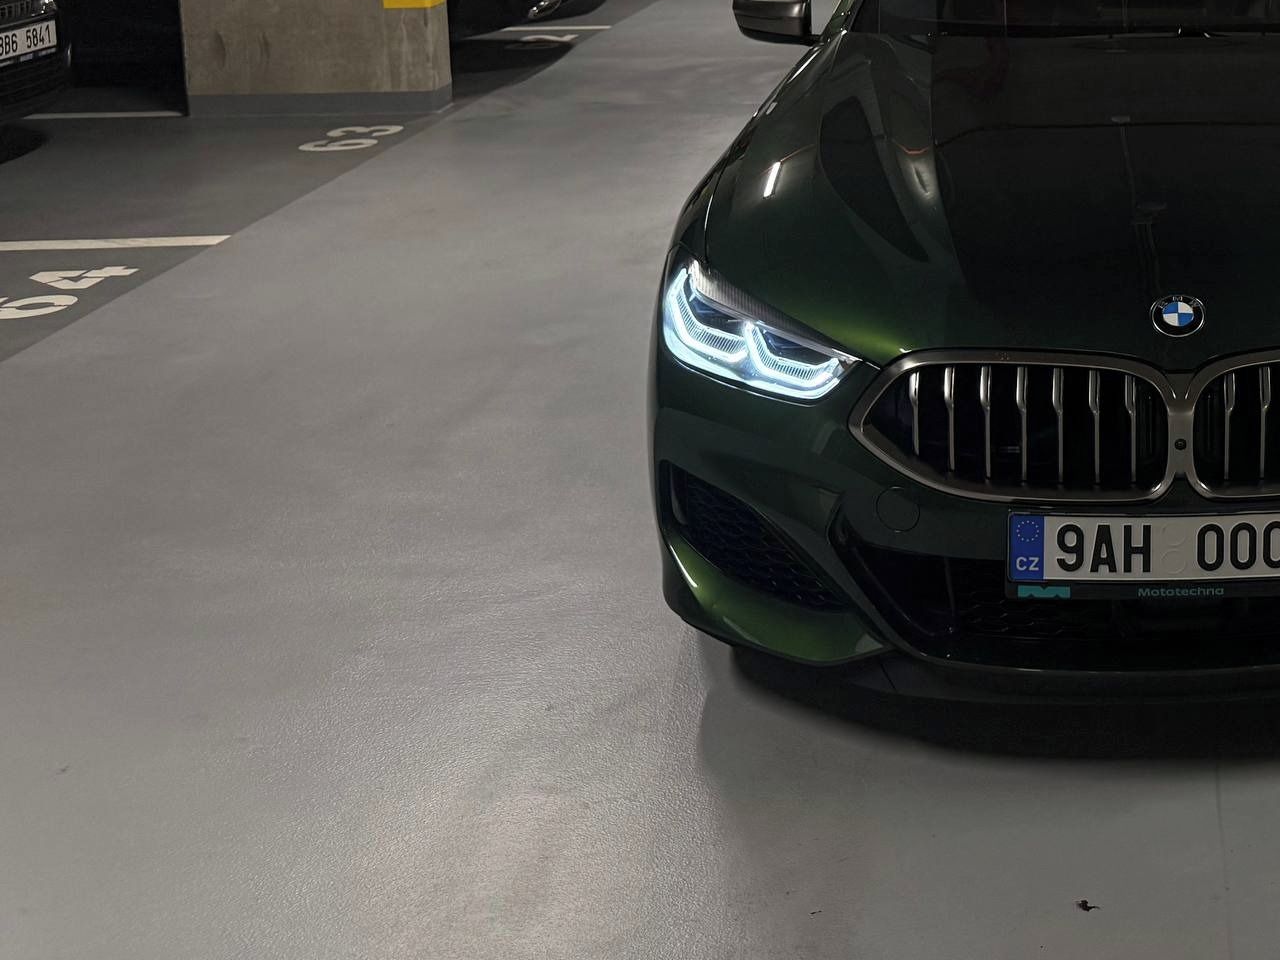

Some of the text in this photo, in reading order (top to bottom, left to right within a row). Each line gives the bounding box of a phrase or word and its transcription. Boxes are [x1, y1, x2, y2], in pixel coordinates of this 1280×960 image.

[25, 24, 51, 49] 5841
[298, 125, 404, 152] 63
[1056, 523, 1152, 573] 9AH
[1015, 556, 1040, 572] CZ
[1137, 586, 1225, 598] Mototechna
